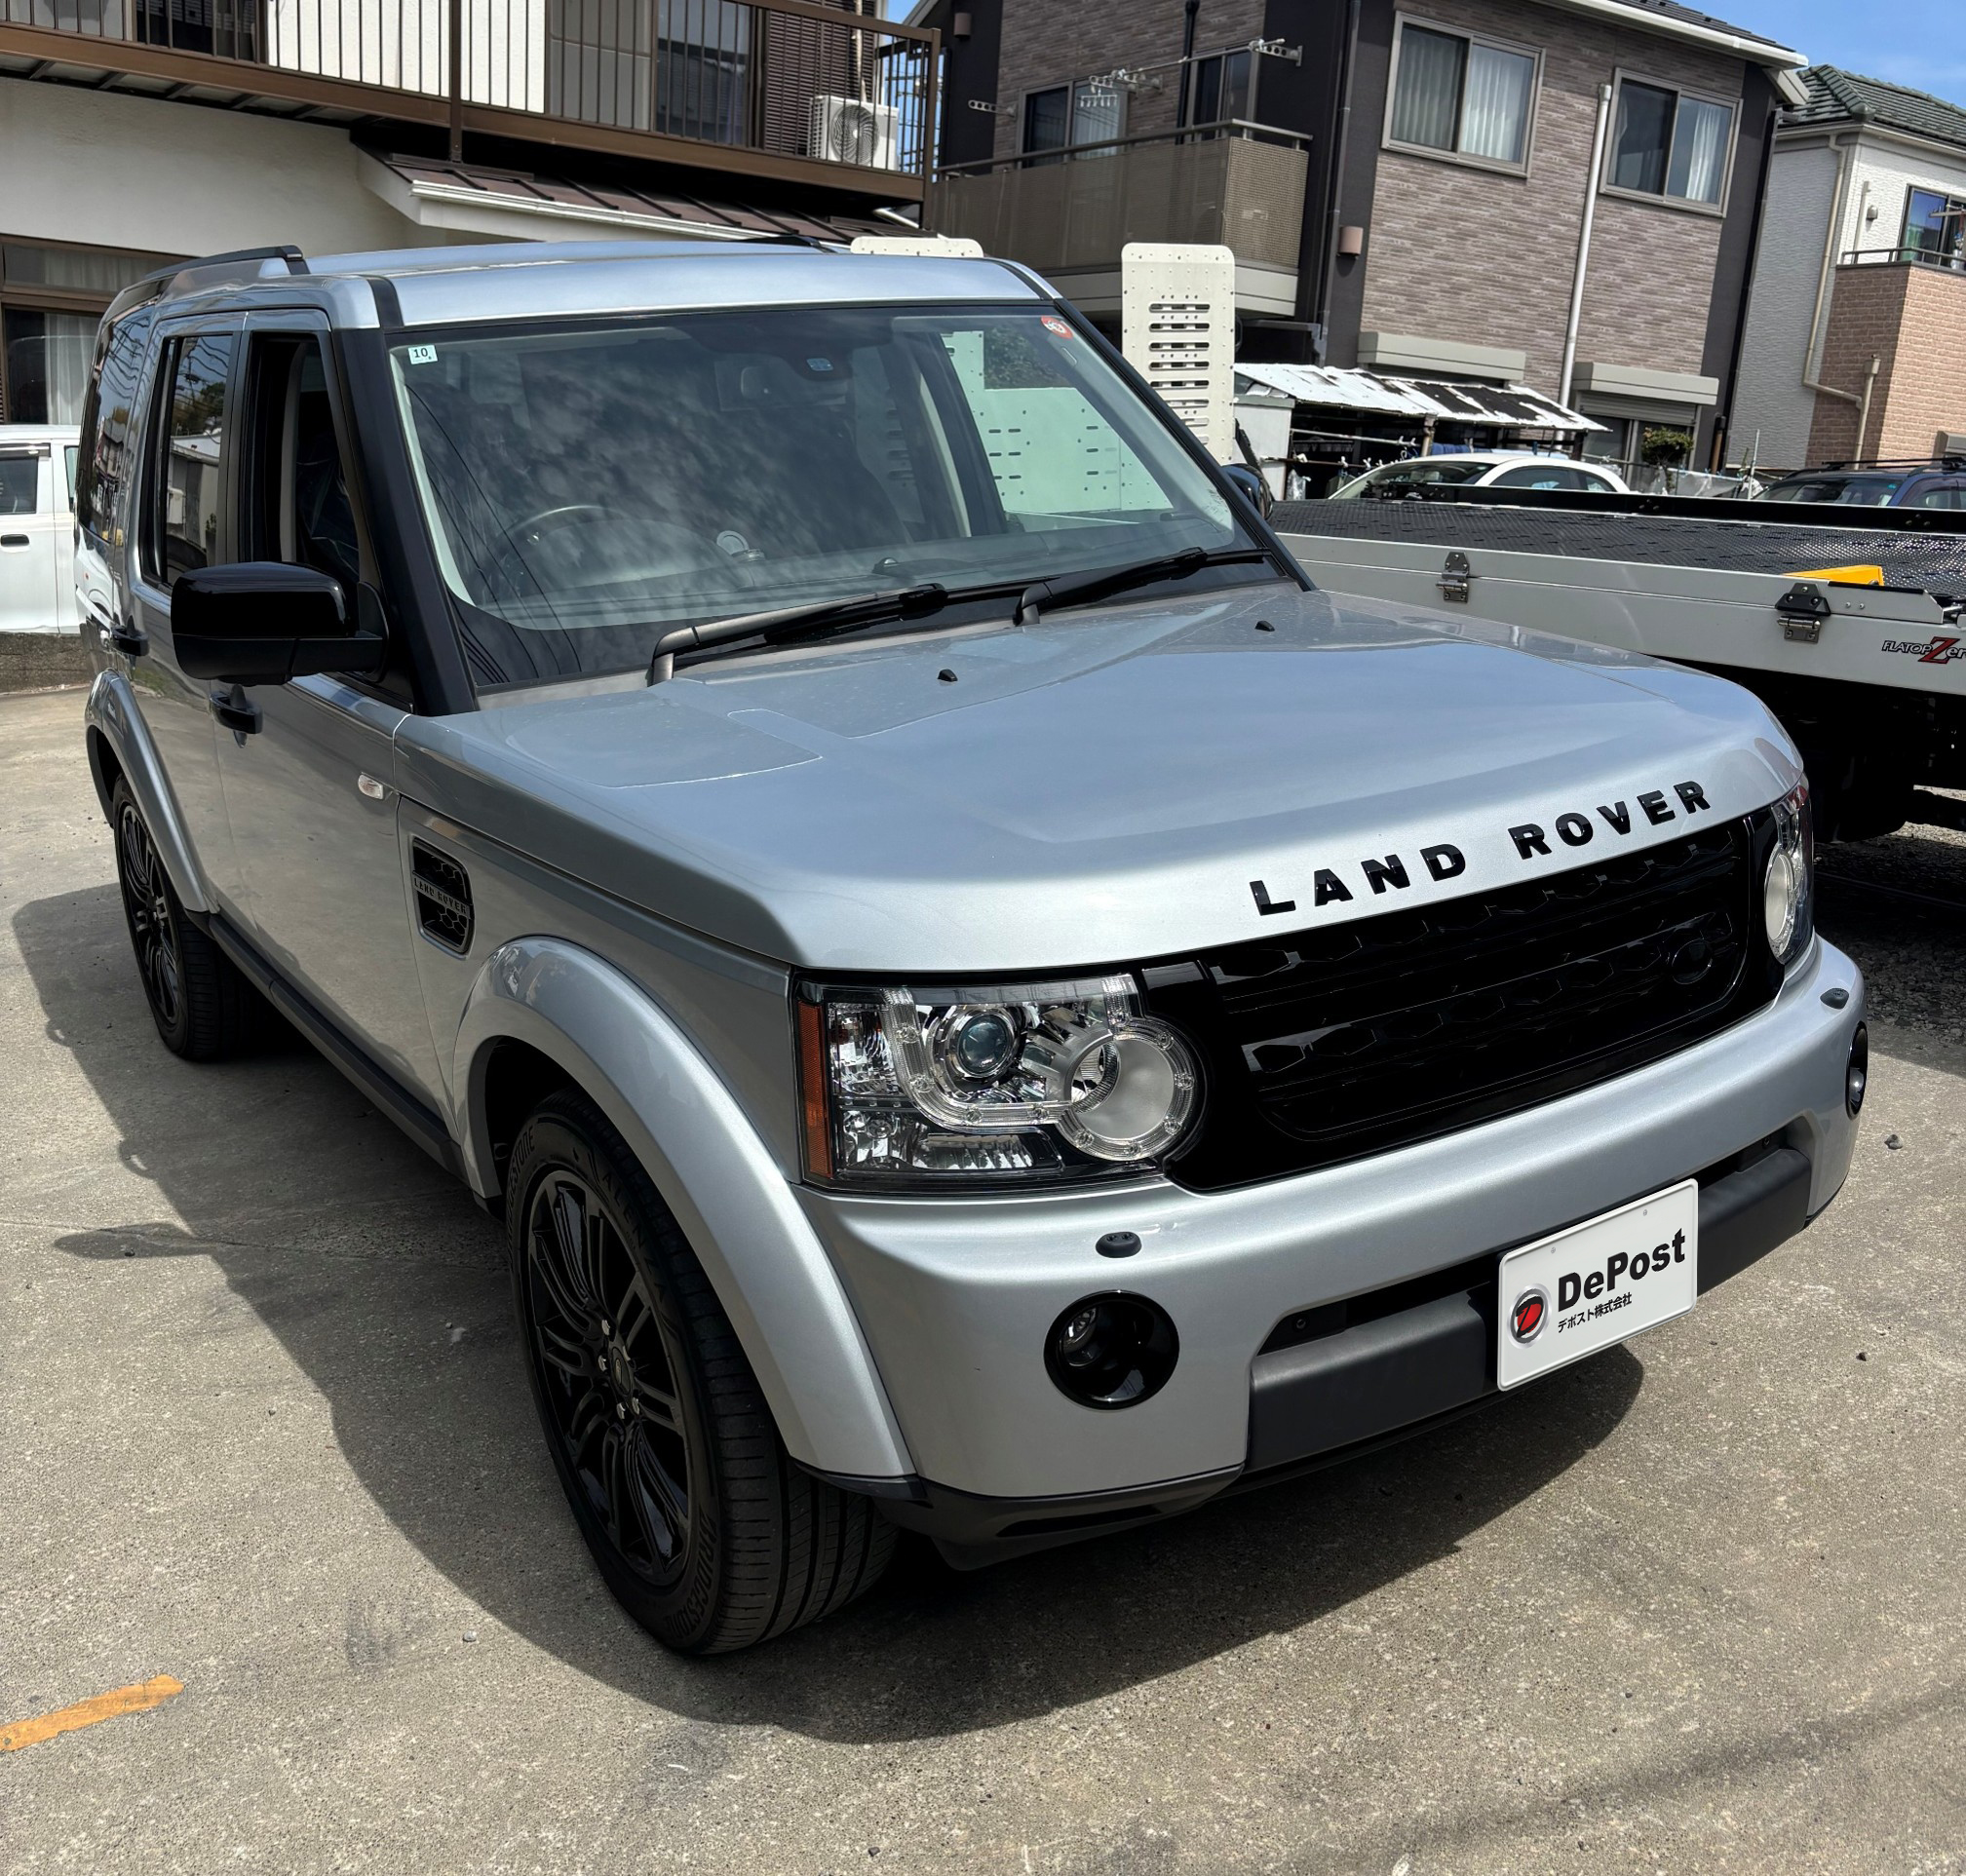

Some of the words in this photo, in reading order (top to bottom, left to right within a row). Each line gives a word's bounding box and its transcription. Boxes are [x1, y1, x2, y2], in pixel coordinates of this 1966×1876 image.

[1250, 843, 1466, 916] LAND
[1508, 781, 1712, 860] ROVER
[1558, 1228, 1685, 1313] DePost
